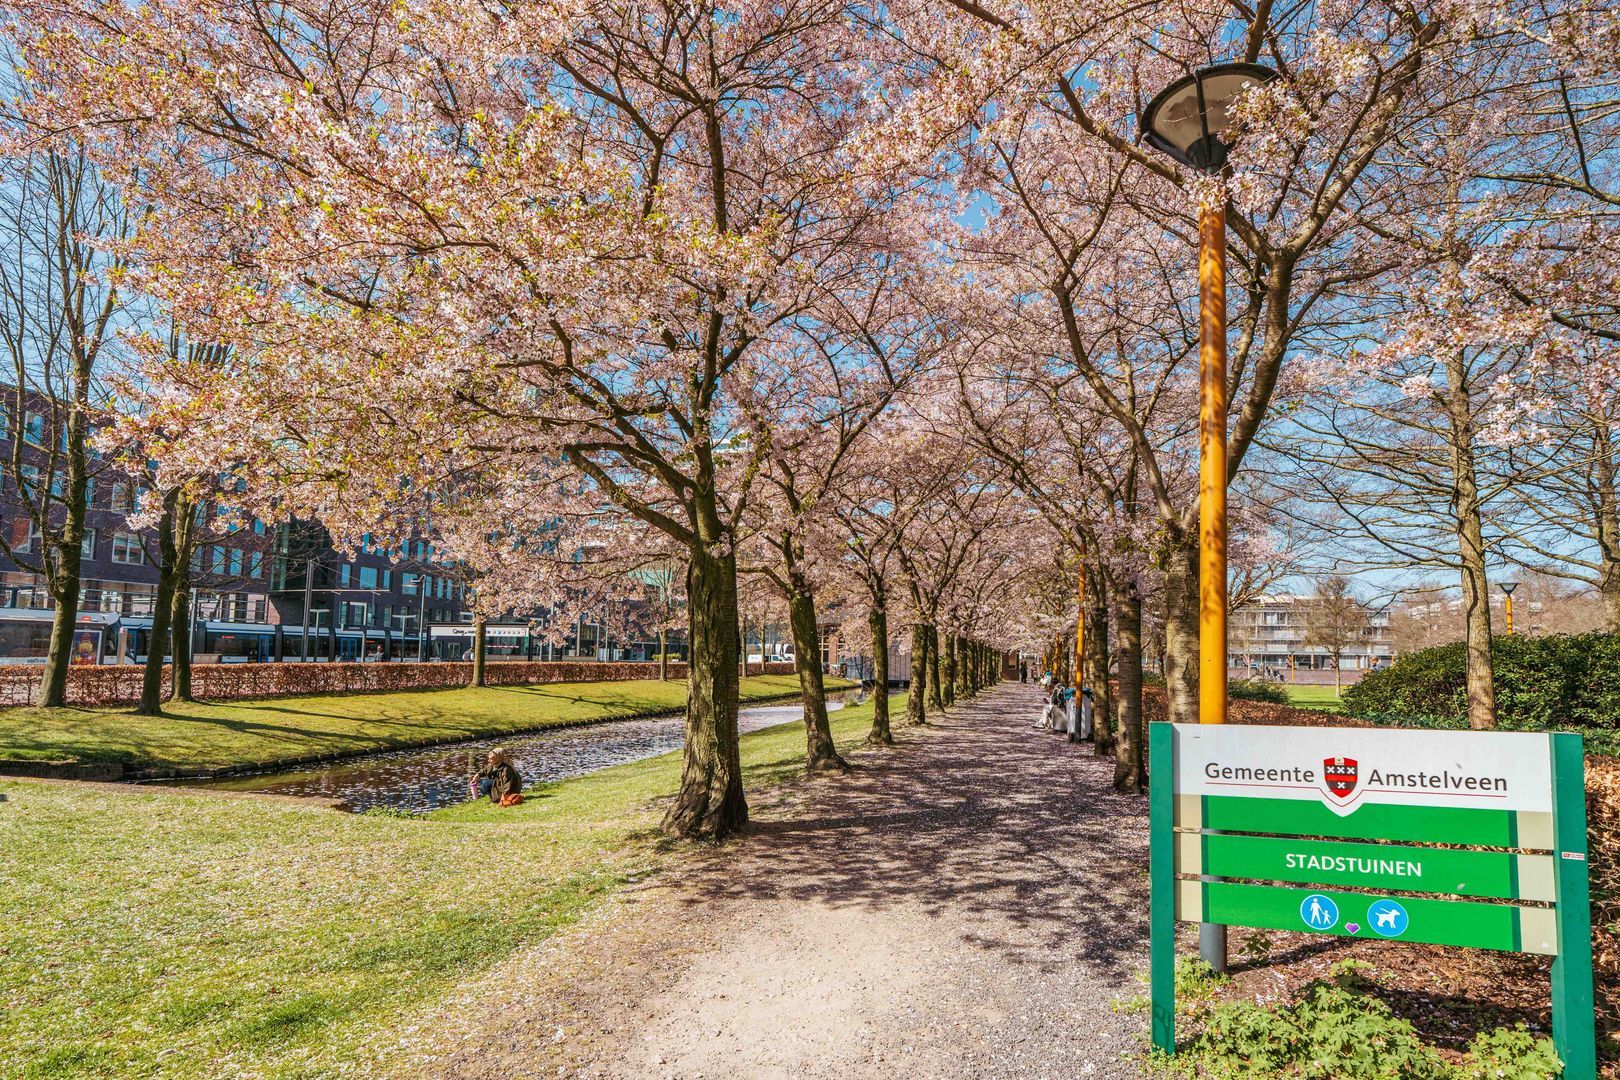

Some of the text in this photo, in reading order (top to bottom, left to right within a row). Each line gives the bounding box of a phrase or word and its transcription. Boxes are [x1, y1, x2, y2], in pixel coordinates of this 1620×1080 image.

[1205, 763, 1507, 792] Gemeente Amstelveen
[1285, 853, 1422, 877] STADSTUINEN
